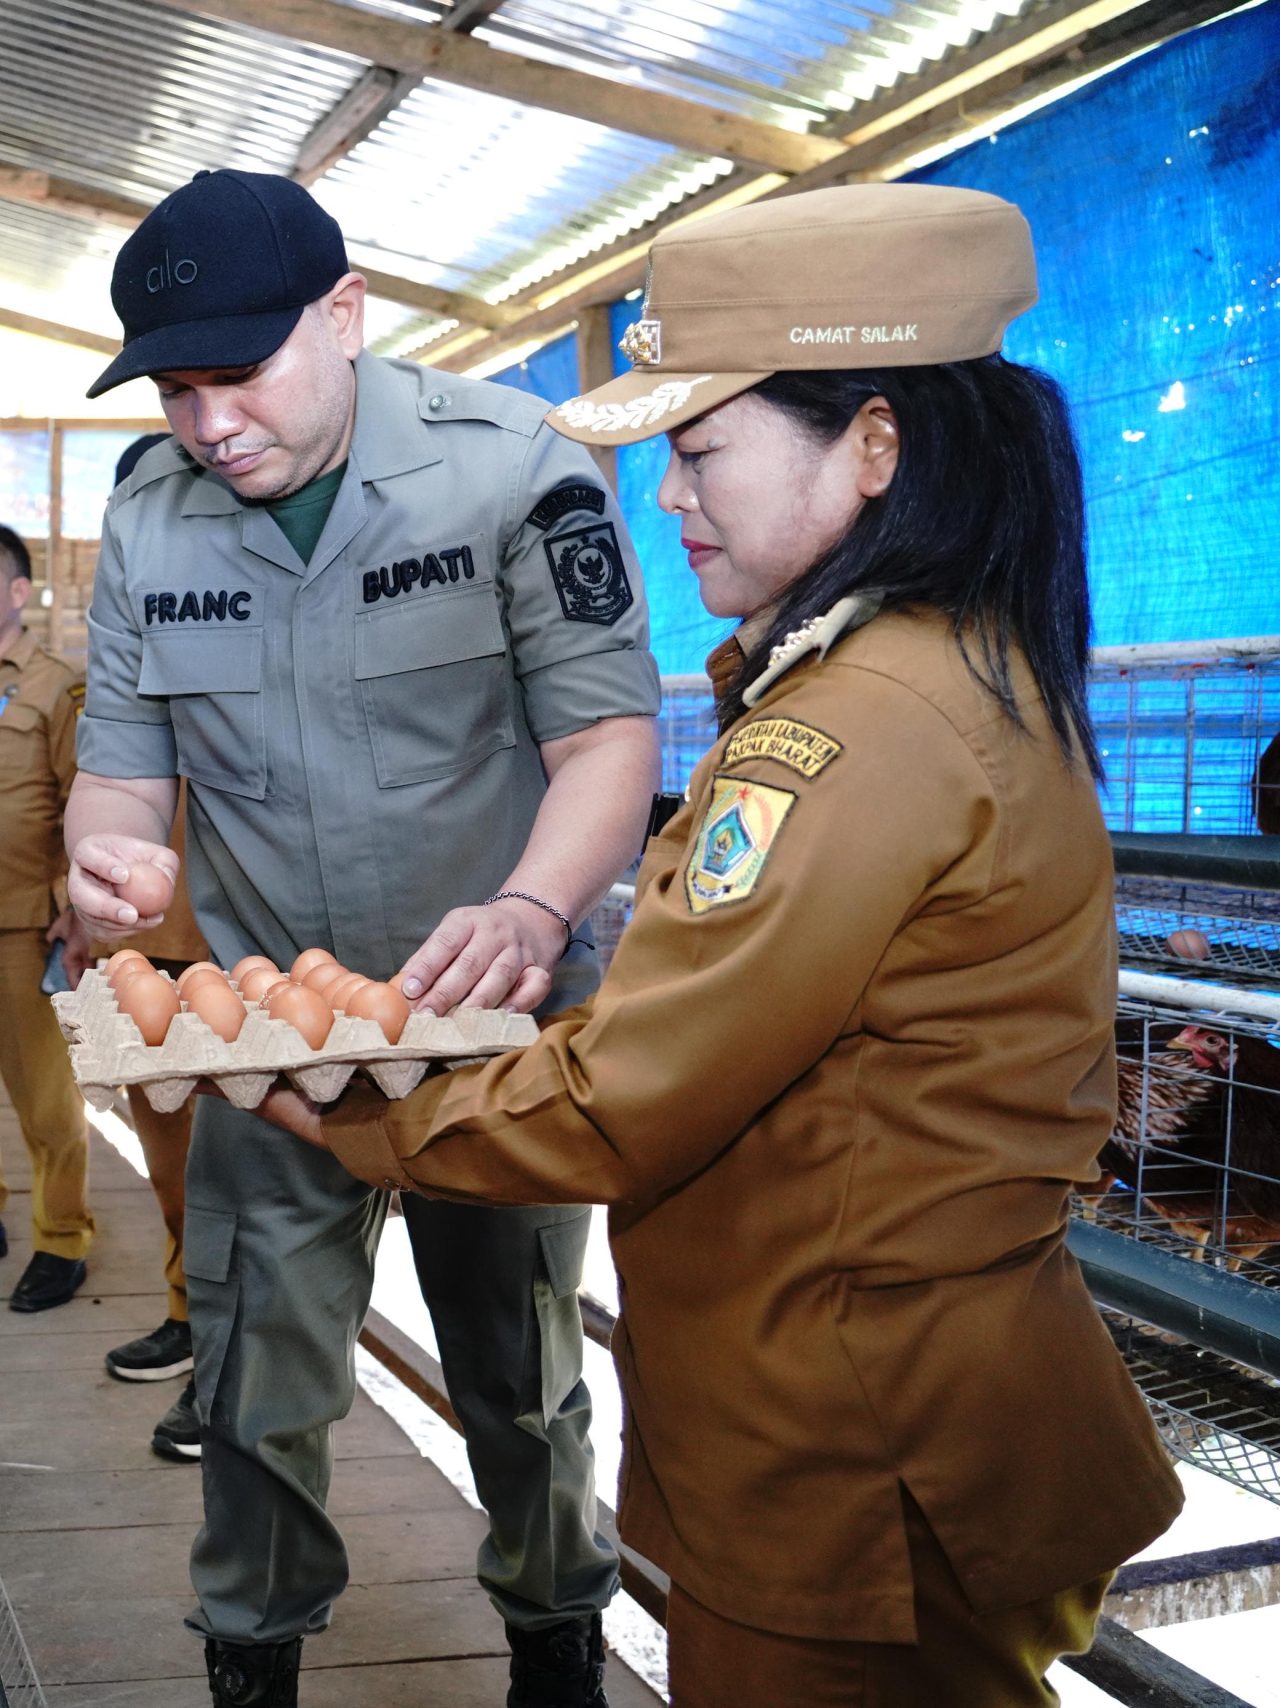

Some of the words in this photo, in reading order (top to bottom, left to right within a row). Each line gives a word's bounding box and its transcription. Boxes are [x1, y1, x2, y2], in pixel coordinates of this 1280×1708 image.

[146, 248, 198, 294] alo
[789, 326, 856, 344] CAMAT
[861, 323, 918, 343] SALAK
[363, 545, 475, 604] BUPATI
[143, 589, 252, 626] FRANC
[765, 740, 821, 771] BHARAT
